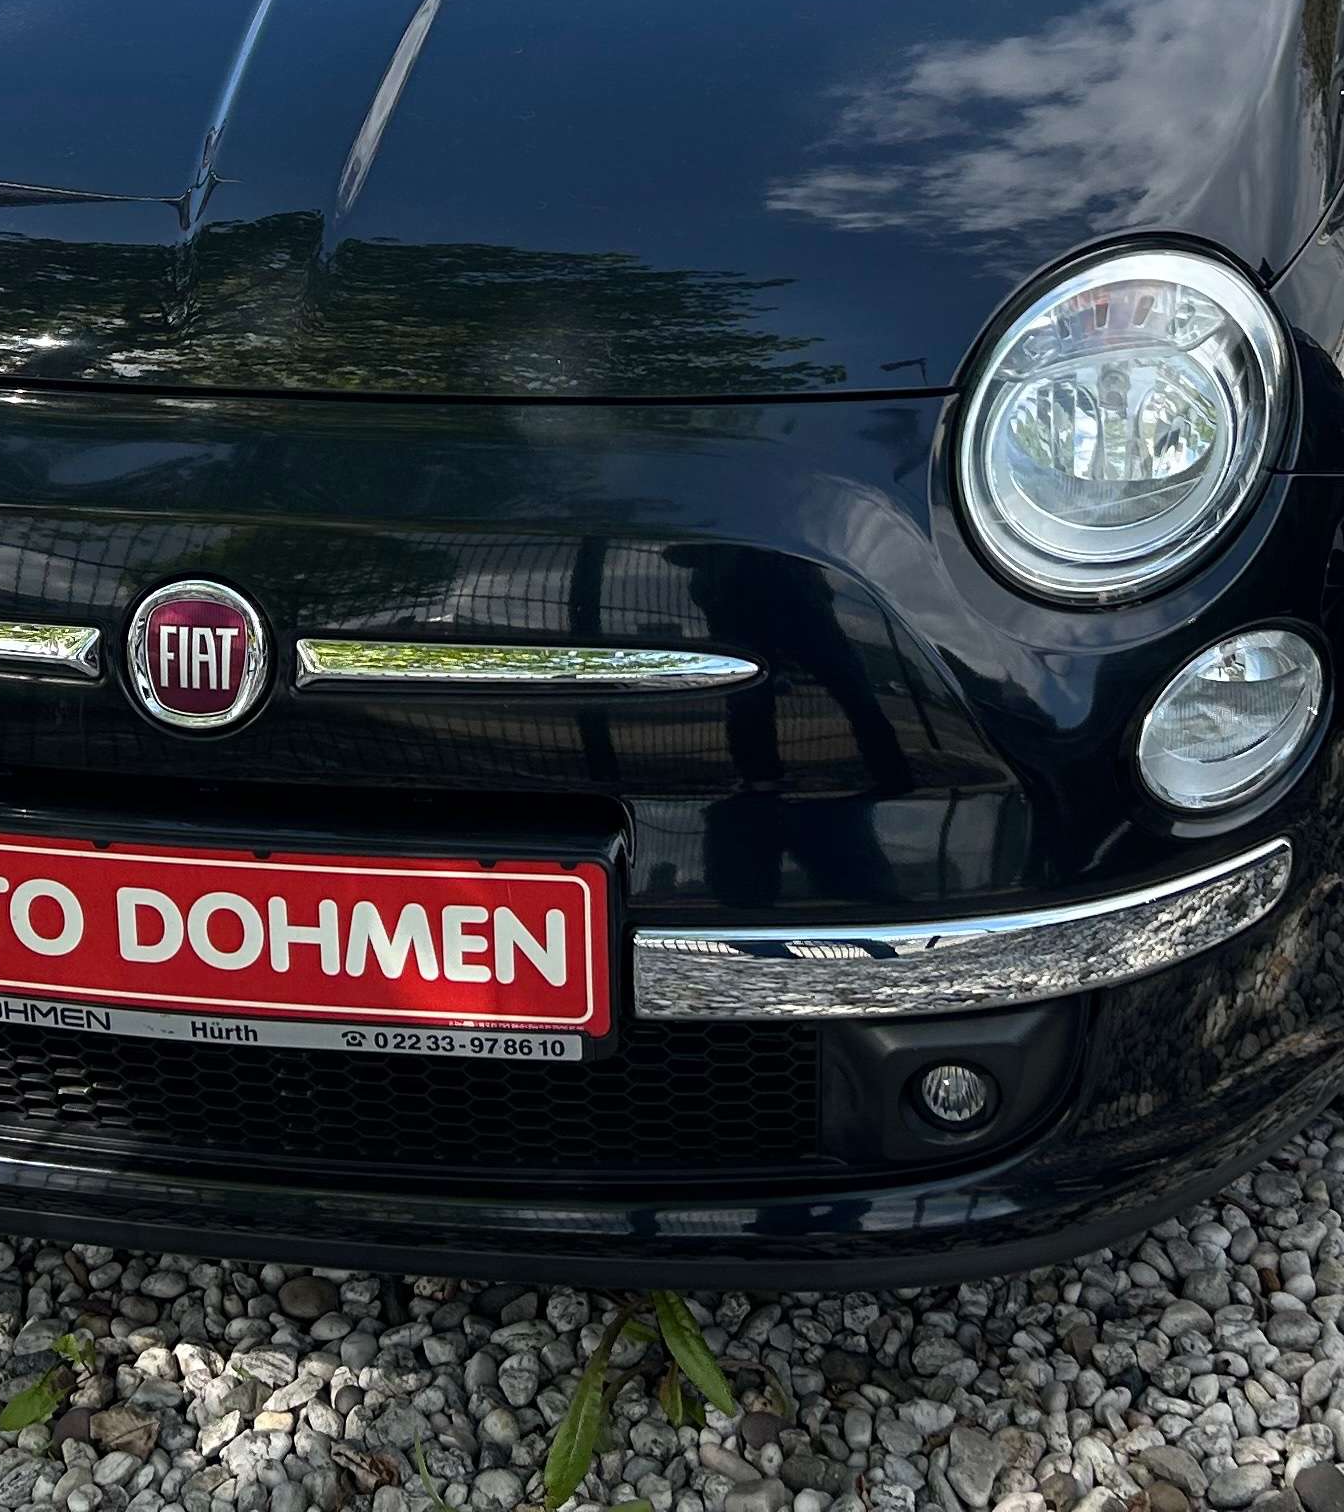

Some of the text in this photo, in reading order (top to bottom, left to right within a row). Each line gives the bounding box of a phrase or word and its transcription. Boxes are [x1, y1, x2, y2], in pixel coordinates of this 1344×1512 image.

[159, 625, 239, 690] FIAT
[116, 885, 568, 988] DOHMEN
[190, 1019, 259, 1043] Hürth
